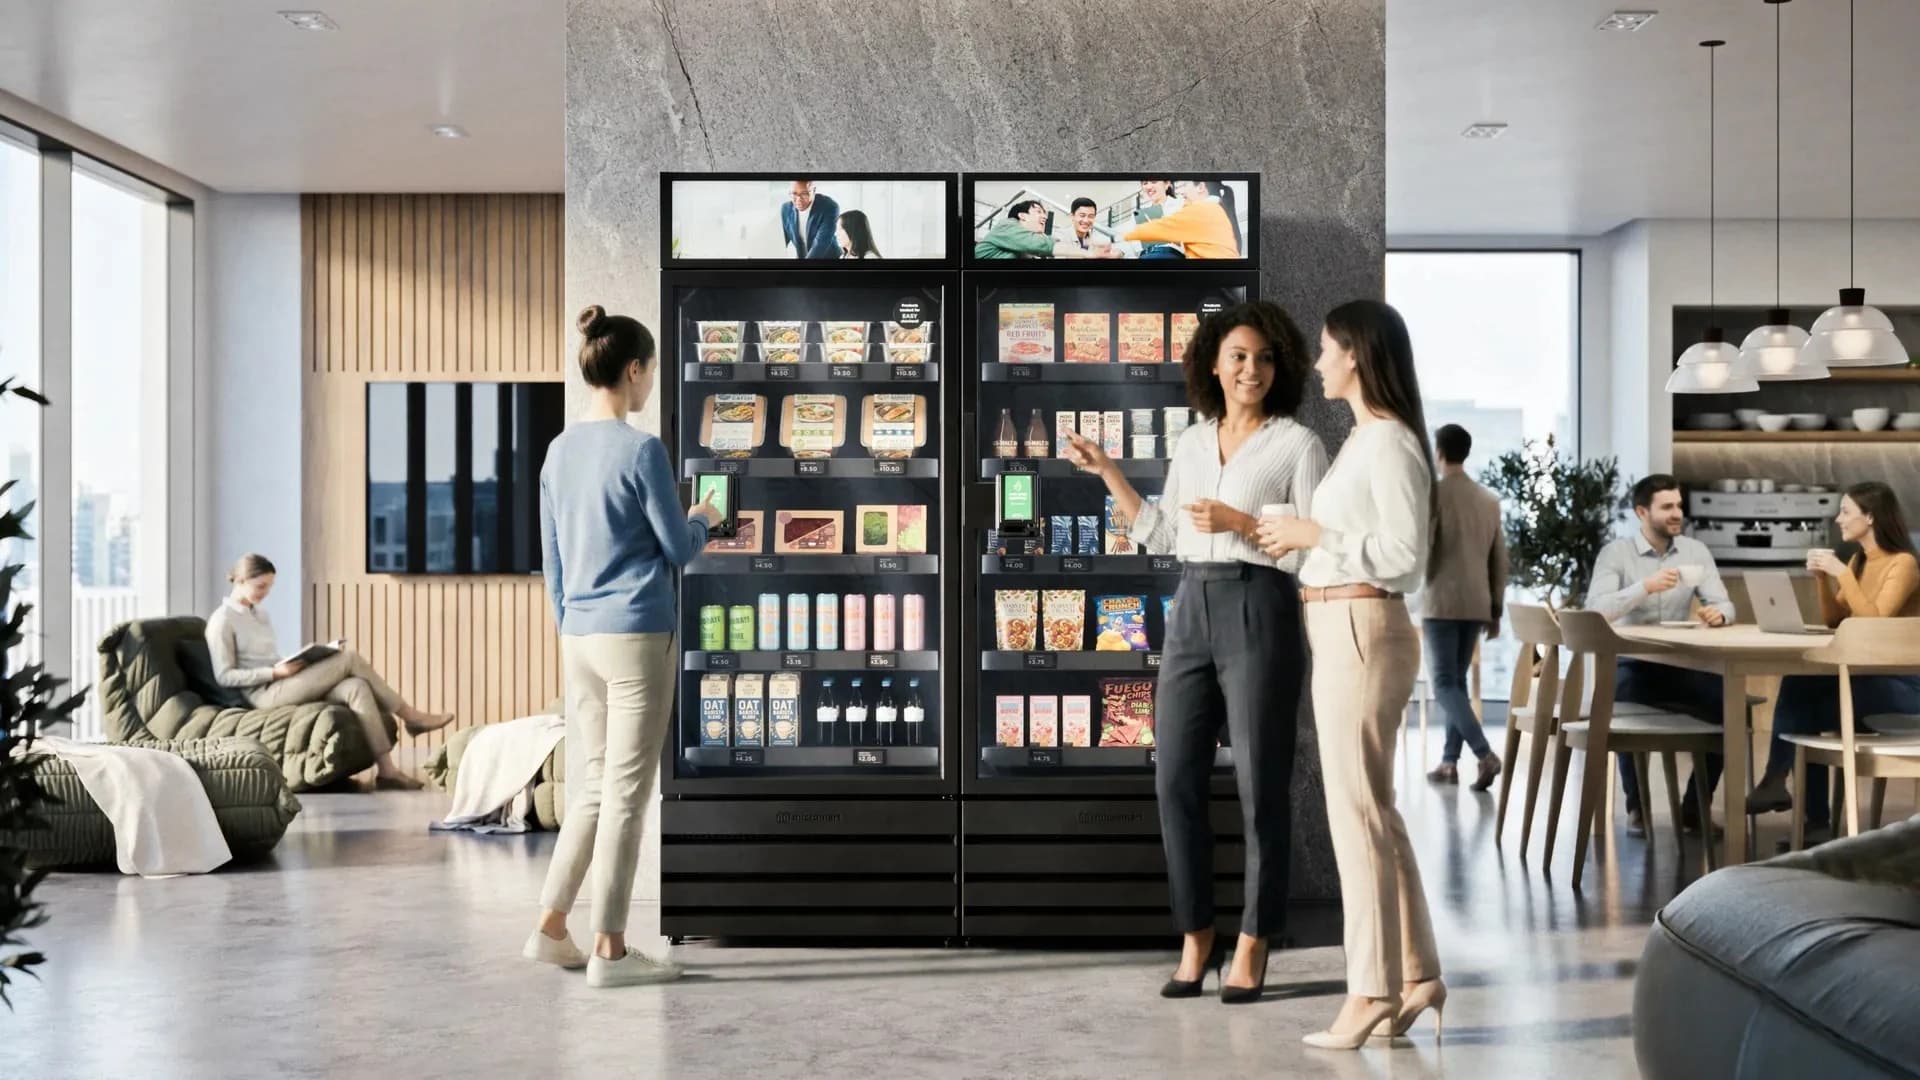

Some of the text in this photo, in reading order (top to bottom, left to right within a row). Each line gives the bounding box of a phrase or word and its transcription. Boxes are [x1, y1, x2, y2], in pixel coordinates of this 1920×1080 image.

[1105, 682, 1152, 695] FUEGO
[1127, 691, 1152, 699] CHIPS
[703, 700, 725, 710] OAT
[738, 700, 760, 710] OAT
[772, 700, 794, 710] OAT
